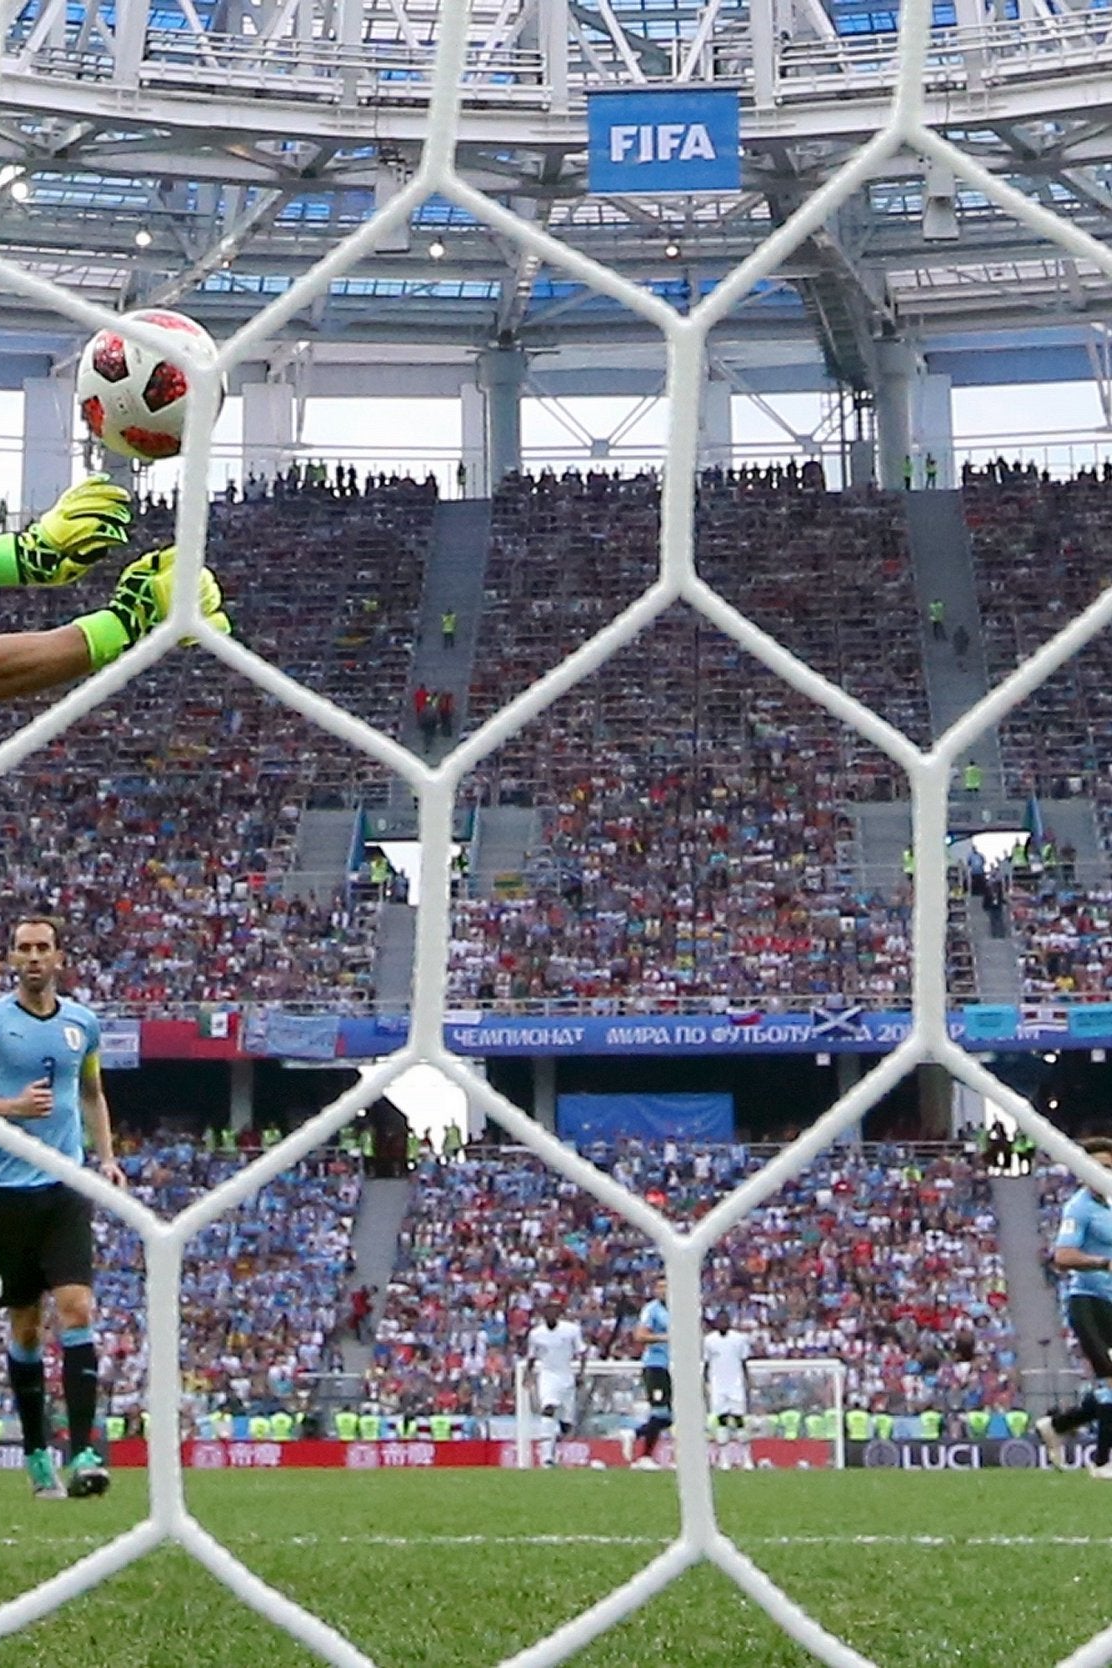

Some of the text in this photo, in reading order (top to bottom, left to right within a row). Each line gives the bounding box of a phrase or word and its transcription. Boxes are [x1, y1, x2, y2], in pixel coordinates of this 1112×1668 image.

[610, 124, 717, 163] FIFA
[453, 1026, 585, 1047] ЧЕМПИОНАТ
[606, 1025, 671, 1045] МИРА
[674, 1025, 707, 1045] ПО
[902, 1444, 980, 1470] LUCI
